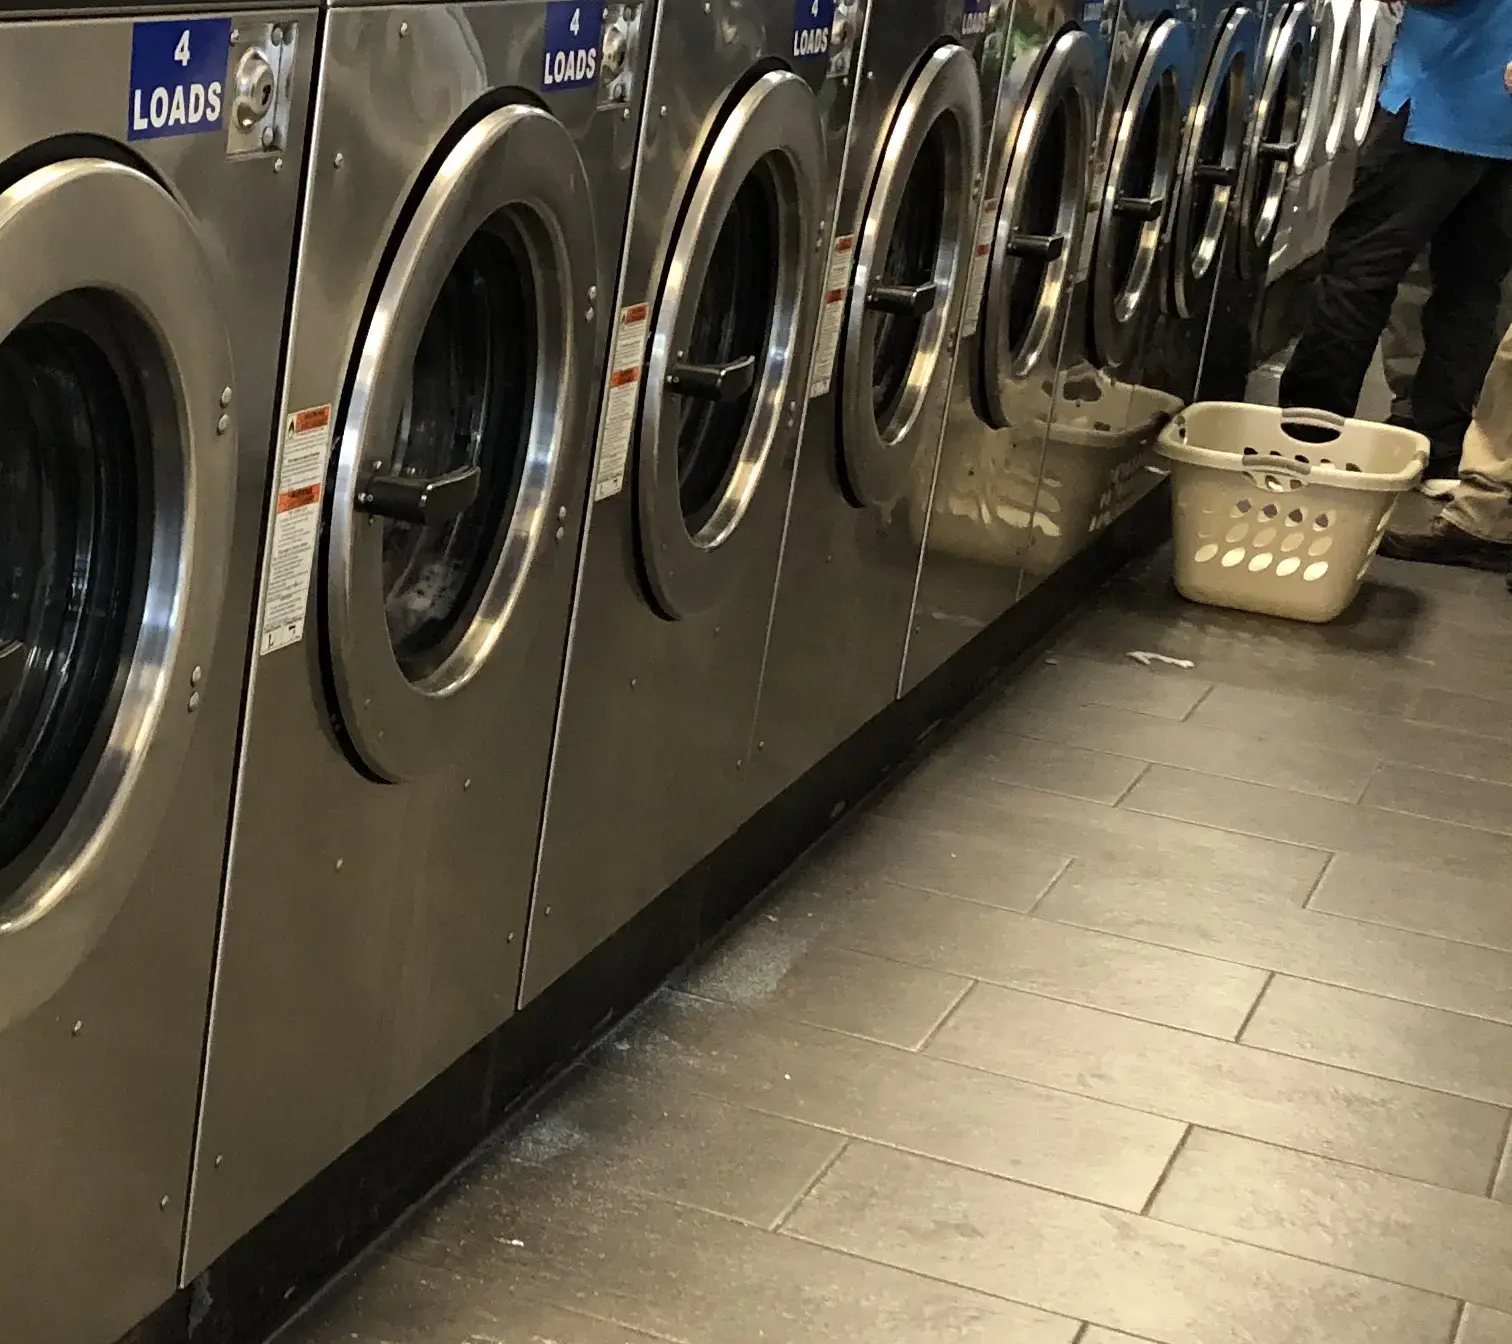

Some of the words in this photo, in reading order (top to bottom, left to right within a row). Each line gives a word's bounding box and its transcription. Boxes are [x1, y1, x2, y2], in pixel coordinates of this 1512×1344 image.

[570, 8, 580, 36] 4
[174, 29, 190, 66] 4
[793, 27, 829, 56] LOADS
[544, 47, 597, 85] LOADS
[133, 81, 222, 131] LOADS
